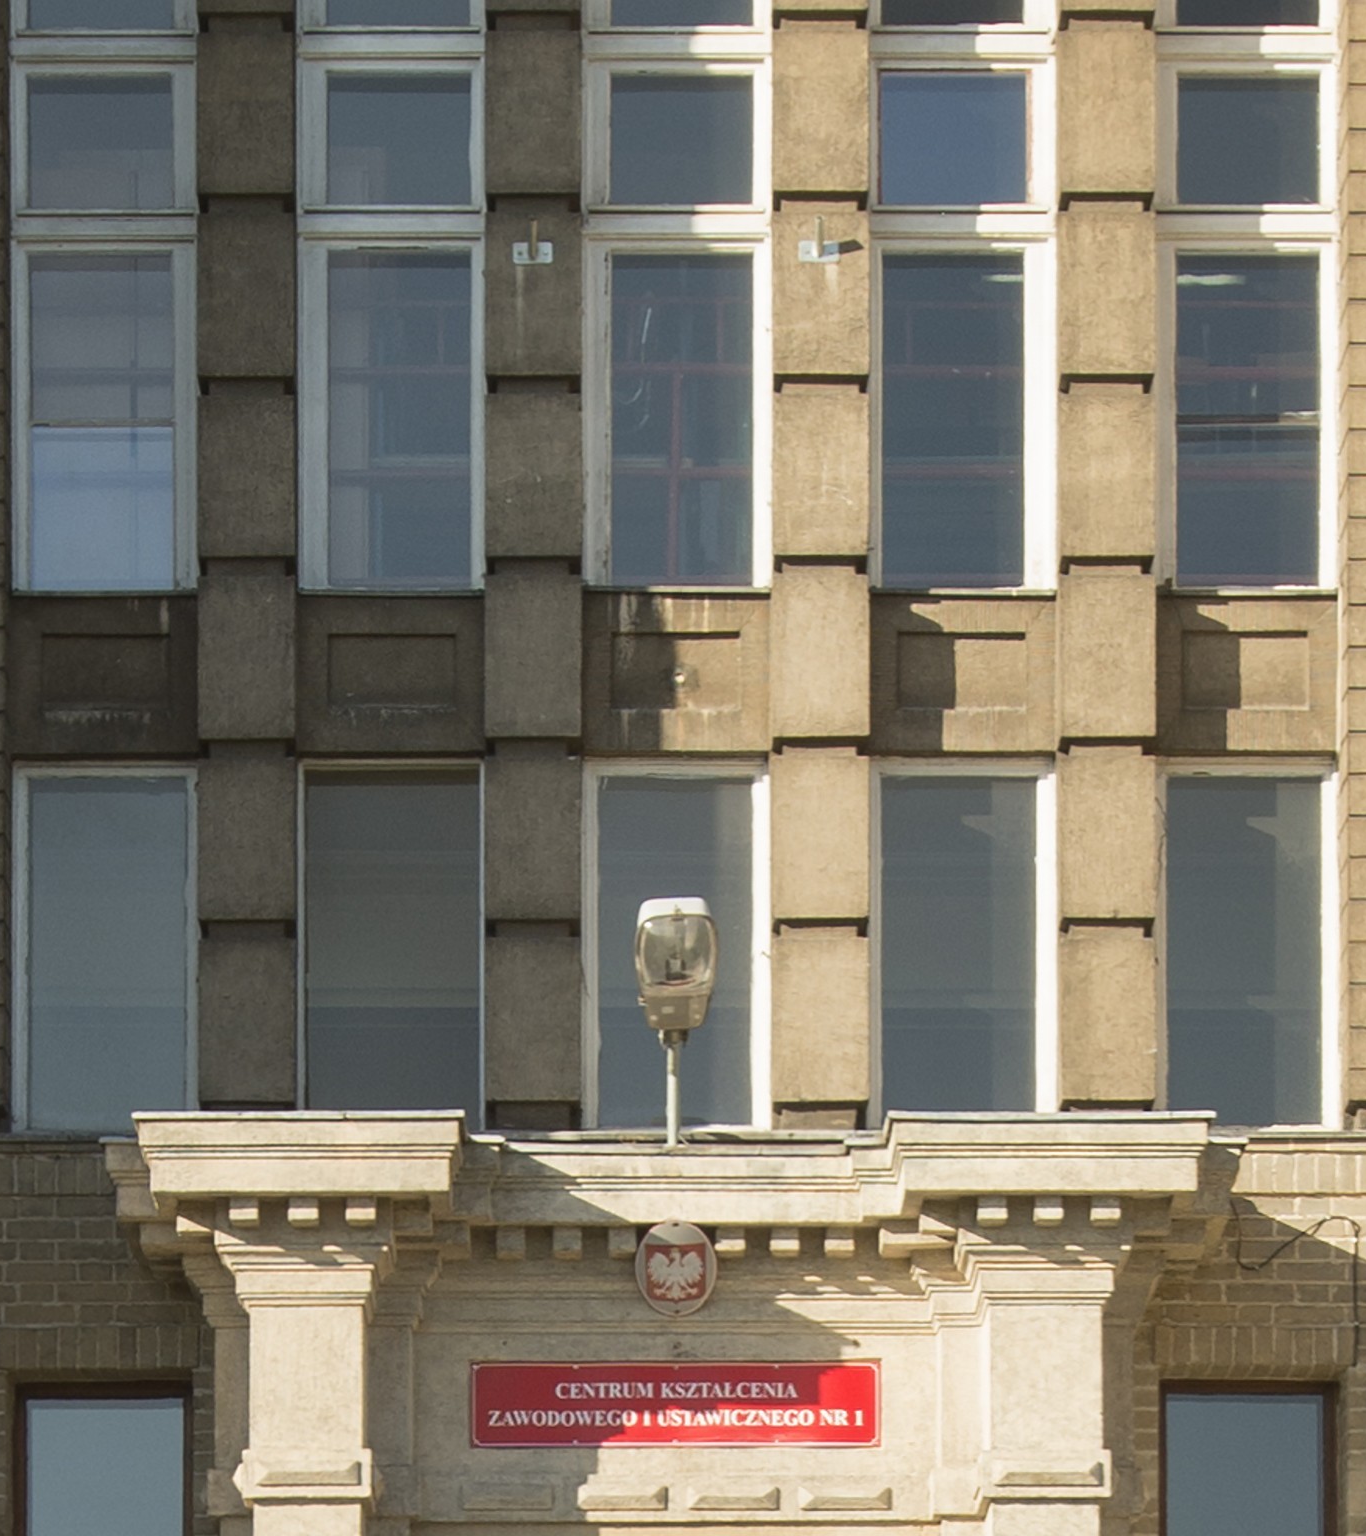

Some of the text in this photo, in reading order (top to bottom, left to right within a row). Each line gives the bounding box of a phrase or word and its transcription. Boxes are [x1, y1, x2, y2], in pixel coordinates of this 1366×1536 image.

[555, 1382, 799, 1399] CENTRUM KSZTAŁCENIA
[488, 1408, 864, 1428] ZAWODOWEGO I USTAWICZNEGO NR 1
